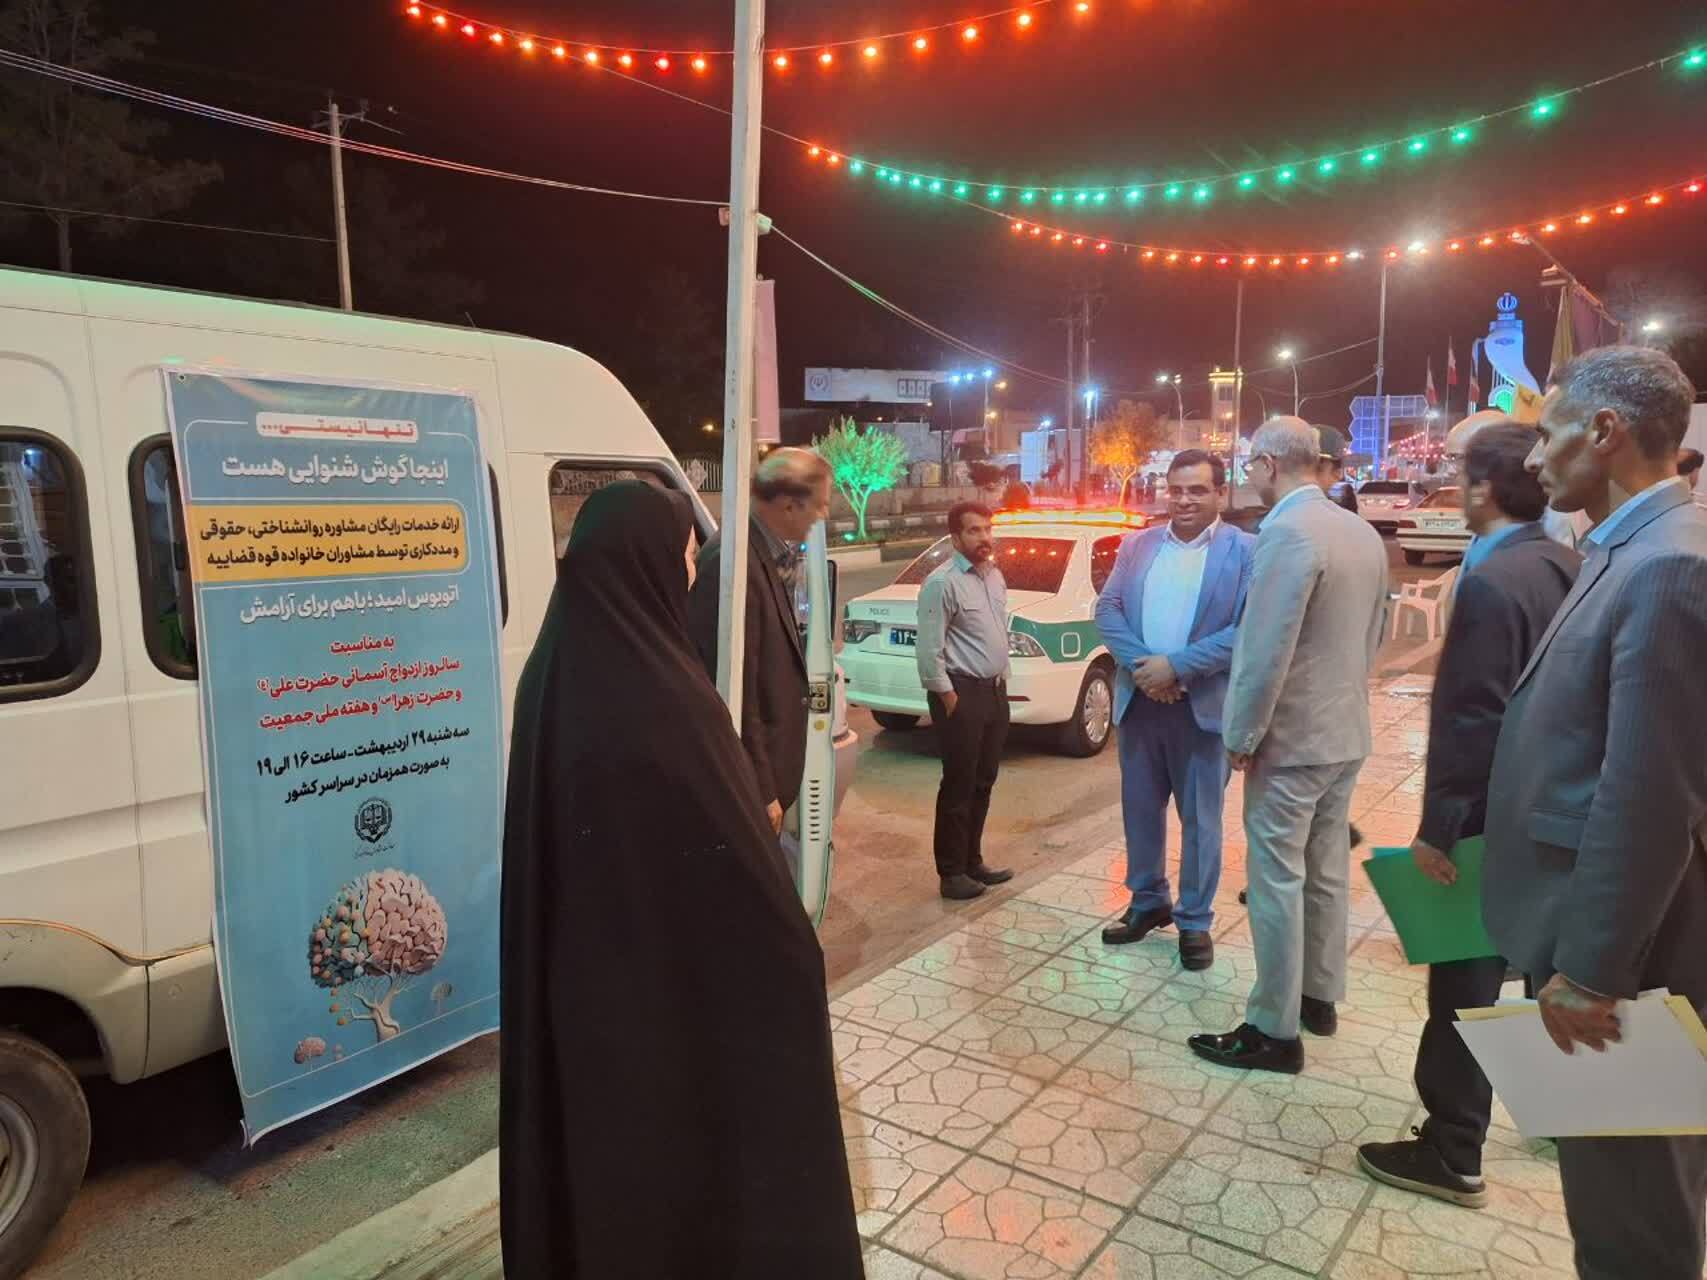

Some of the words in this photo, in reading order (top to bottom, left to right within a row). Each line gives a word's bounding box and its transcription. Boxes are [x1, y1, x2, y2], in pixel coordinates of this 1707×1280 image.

[222, 455, 287, 477] هست
[289, 453, 360, 485] شنوایی
[361, 453, 409, 484] گوش
[410, 457, 449, 484] اینجا
[200, 518, 246, 541] حقوقی
[325, 518, 367, 537] مشاوره
[367, 515, 401, 536] رایگان
[402, 517, 440, 532] خدمات
[207, 546, 256, 569] قضاییه
[258, 545, 280, 567] قوه
[281, 545, 325, 565] خانواده
[326, 543, 375, 563] مشاوران
[376, 543, 409, 560] توسط
[409, 542, 452, 560] مددکاری
[297, 593, 329, 619] برای
[407, 584, 460, 609] اتوبوس
[240, 592, 297, 624] آرامش
[330, 635, 382, 656] مناسبت
[383, 635, 395, 652] به
[342, 662, 388, 689] آسمانی
[389, 661, 422, 683] ازدواج
[422, 657, 460, 677] سالروز
[295, 672, 340, 693] حضرت
[416, 686, 455, 706] حضرت
[316, 704, 339, 724] ملی
[340, 699, 372, 716] هفته
[260, 709, 314, 730] جمعیت
[353, 734, 409, 756] اردیبهشت
[256, 756, 272, 776] ۱۹
[273, 754, 290, 776] الی
[294, 751, 309, 769] ۱۶
[310, 747, 347, 765] ساعت
[440, 755, 450, 770] به
[369, 764, 409, 784] همزمان
[409, 759, 440, 776] صورت
[285, 779, 318, 804] کشور
[318, 776, 354, 796] سراسر
[355, 774, 368, 789] در
